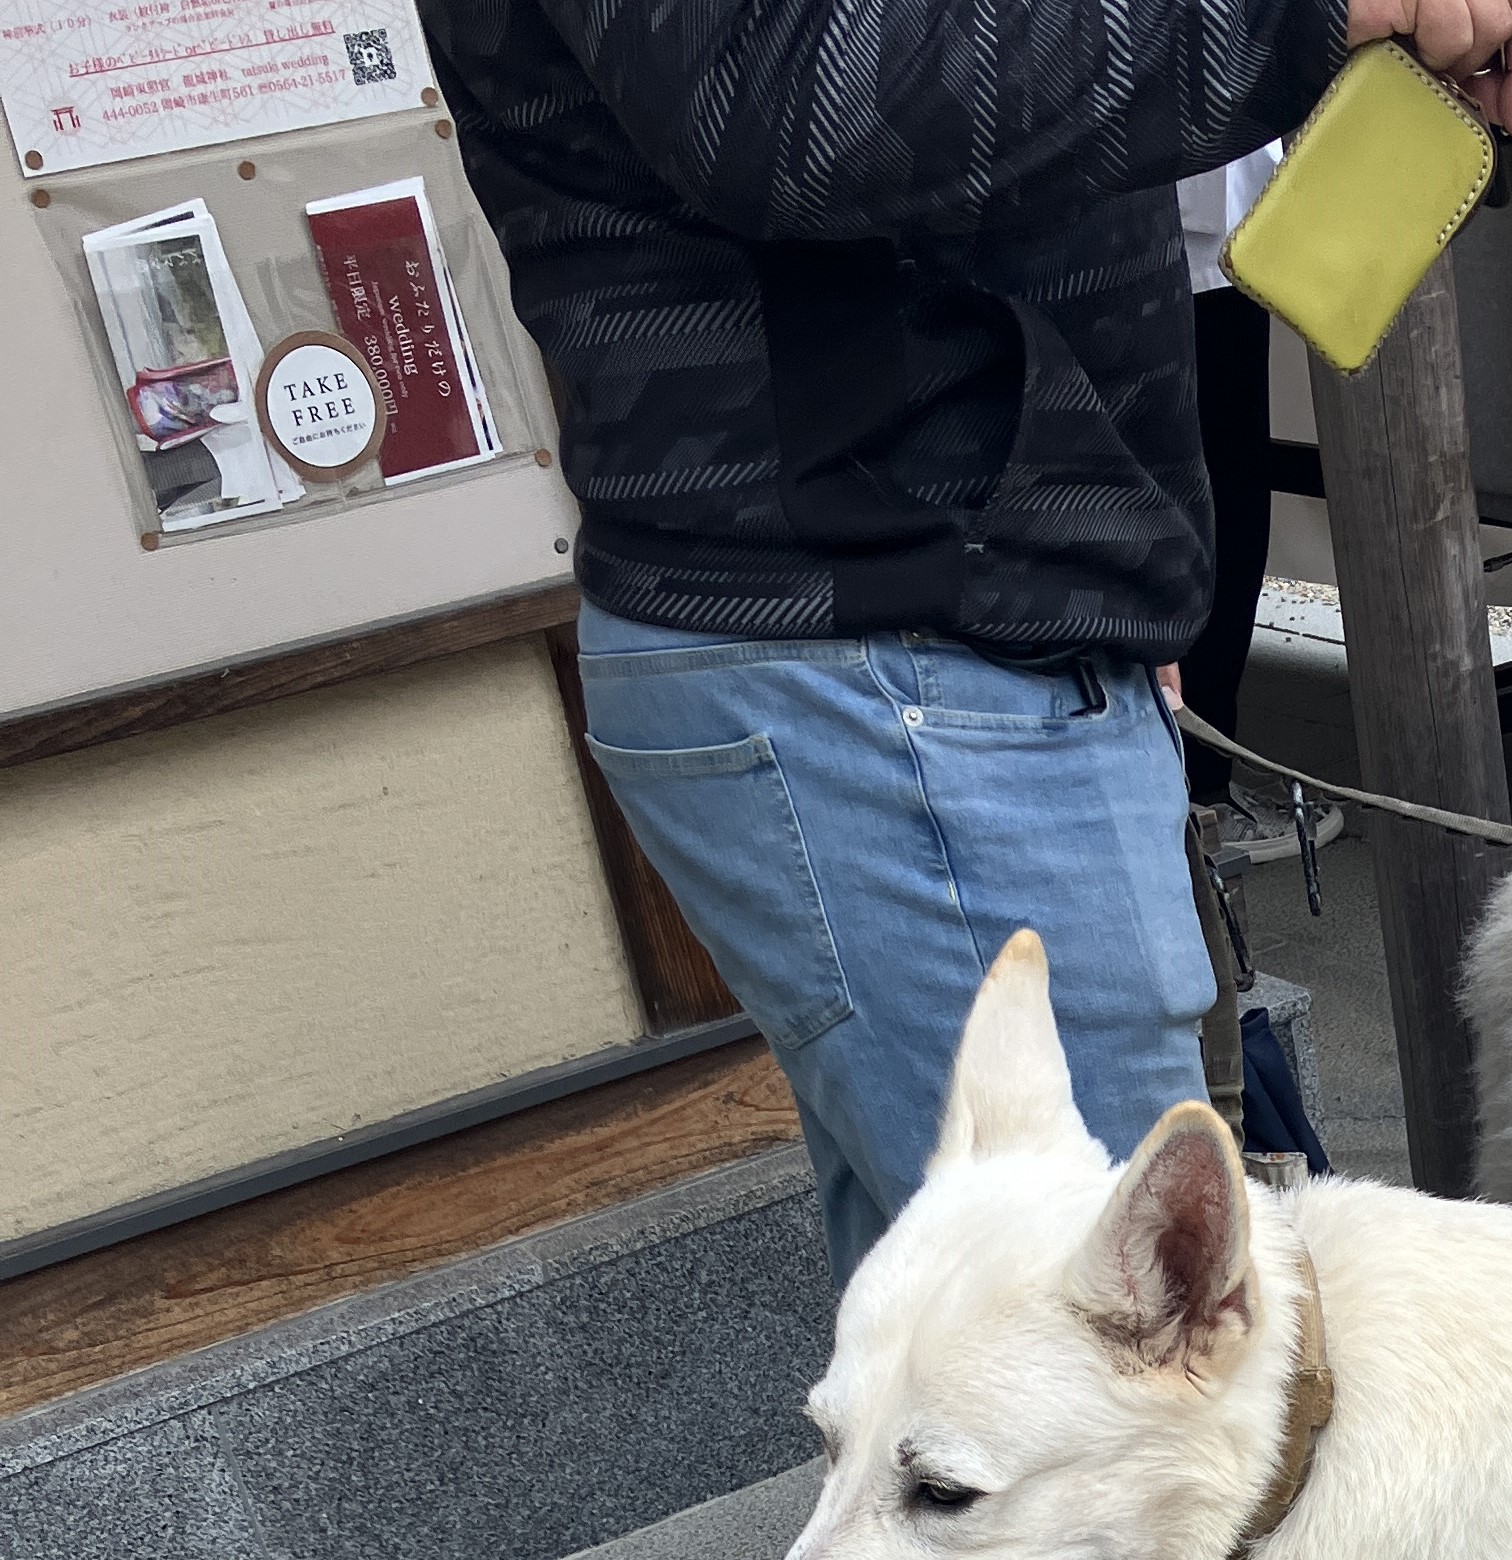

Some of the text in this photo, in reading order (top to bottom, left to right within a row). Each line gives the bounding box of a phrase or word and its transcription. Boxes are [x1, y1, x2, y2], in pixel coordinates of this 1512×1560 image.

[281, 54, 329, 72] wedding
[102, 101, 160, 121] 444-0052
[343, 254, 371, 321] 平日限定
[388, 295, 418, 376] wedding
[405, 260, 450, 397] おふたりだけの
[283, 372, 349, 402] TAKE
[292, 397, 356, 427] FREE
